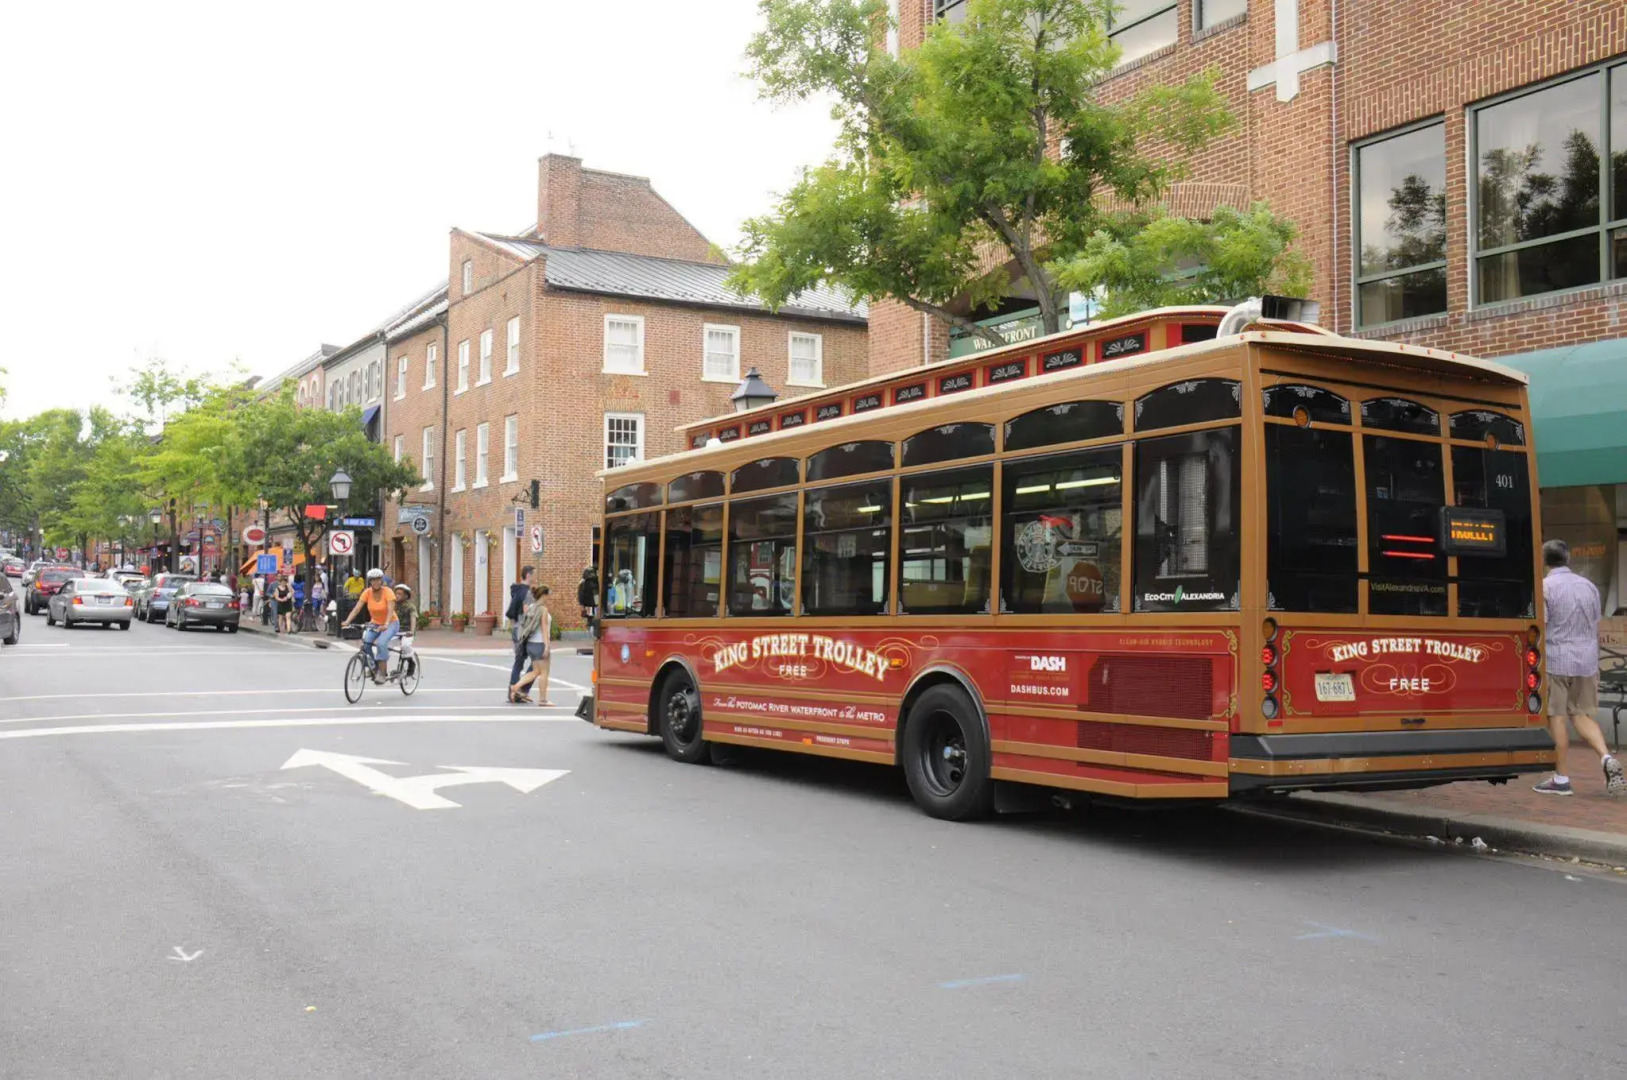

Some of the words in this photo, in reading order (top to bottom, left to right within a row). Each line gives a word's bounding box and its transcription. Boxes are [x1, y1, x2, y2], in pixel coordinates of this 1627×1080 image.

[973, 326, 1037, 350] WATFRONT
[1495, 474, 1513, 488] 401
[1181, 592, 1225, 600] ALEXANDRIA
[1175, 638, 1213, 647] TECHNOLOGY
[713, 641, 748, 673] KING
[752, 633, 809, 658] STREET
[812, 634, 890, 682] TROLLEY
[1332, 641, 1368, 662] KING
[1372, 638, 1422, 654] STREET
[1425, 639, 1482, 663] TROLLEY
[1030, 655, 1066, 671] DASH
[779, 664, 807, 677] FREE
[1010, 684, 1069, 697] DASHBUS.COM
[1389, 678, 1431, 691] FREE
[736, 701, 767, 711] POTOMAC
[768, 703, 789, 713] RIVER
[790, 705, 837, 718] WATERFRONT
[856, 711, 885, 722] METRO
